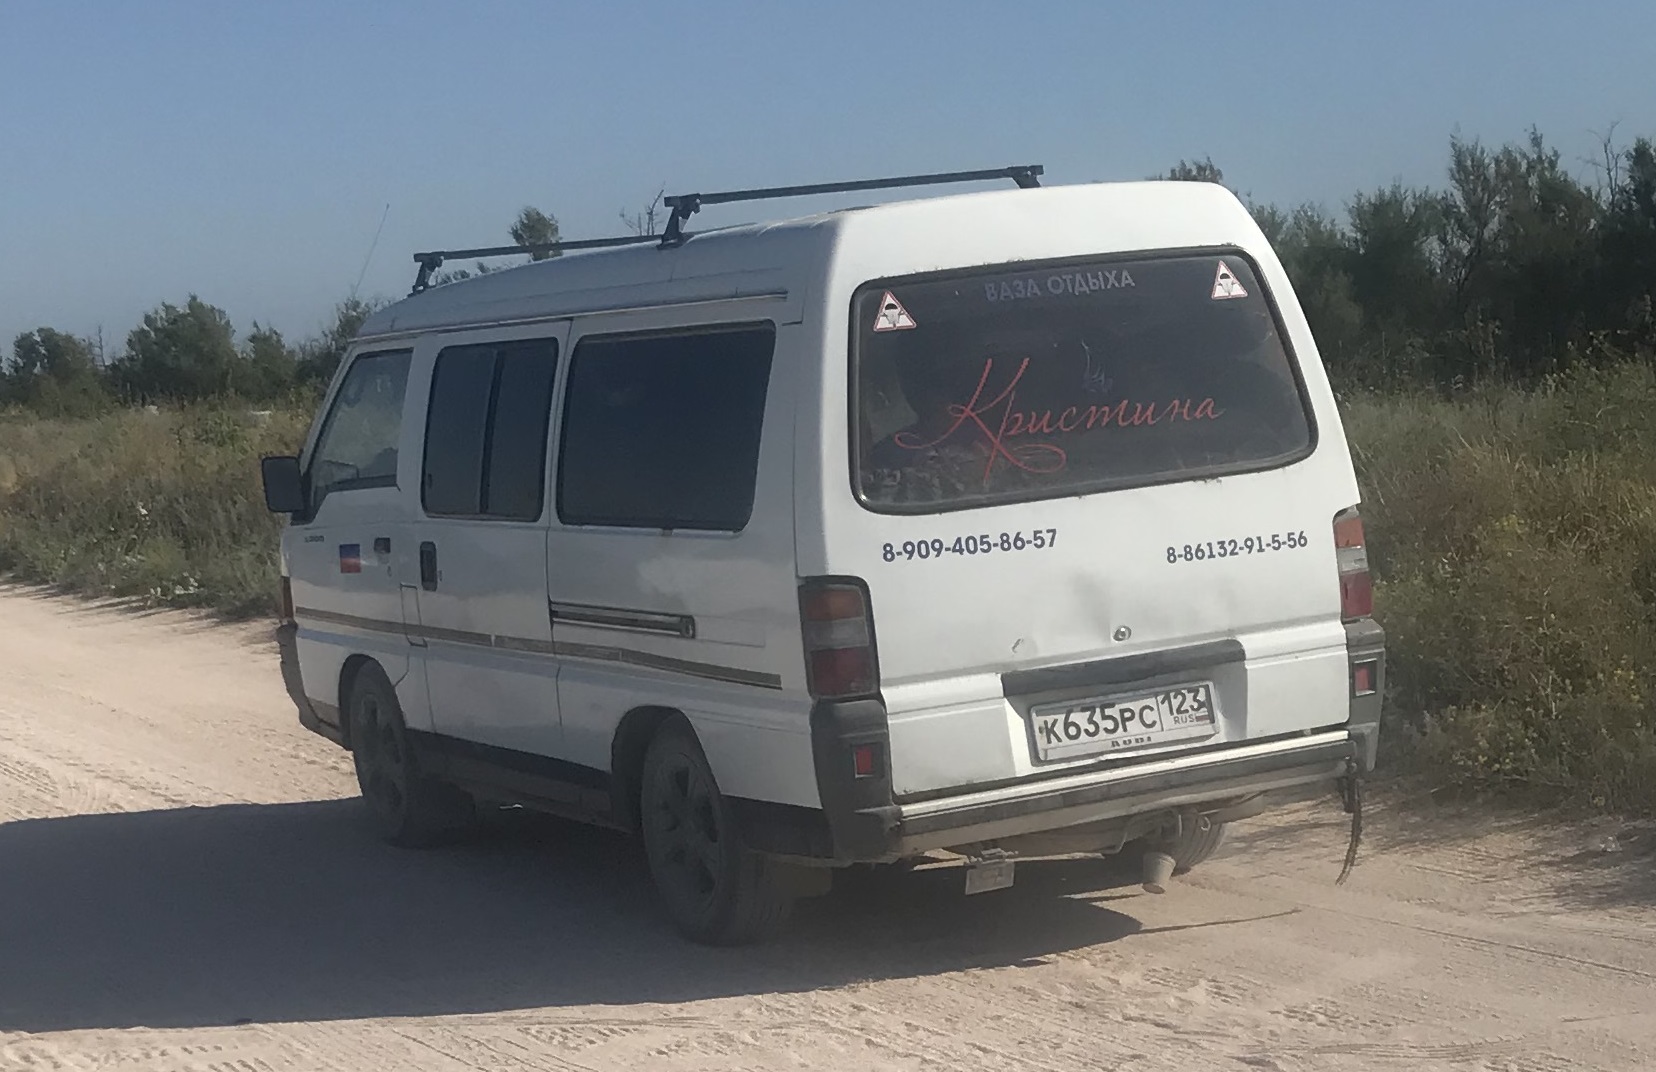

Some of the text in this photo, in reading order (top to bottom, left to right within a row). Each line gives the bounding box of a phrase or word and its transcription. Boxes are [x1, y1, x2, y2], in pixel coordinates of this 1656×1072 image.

[1046, 269, 1136, 296] ОТДЫХА
[894, 357, 1225, 486] Кристина
[882, 528, 1057, 562] 8-909-405-86-57
[1166, 530, 1308, 564] 8-86132-91-5-56
[1161, 688, 1207, 717] 123
[1173, 714, 1195, 725] RUS
